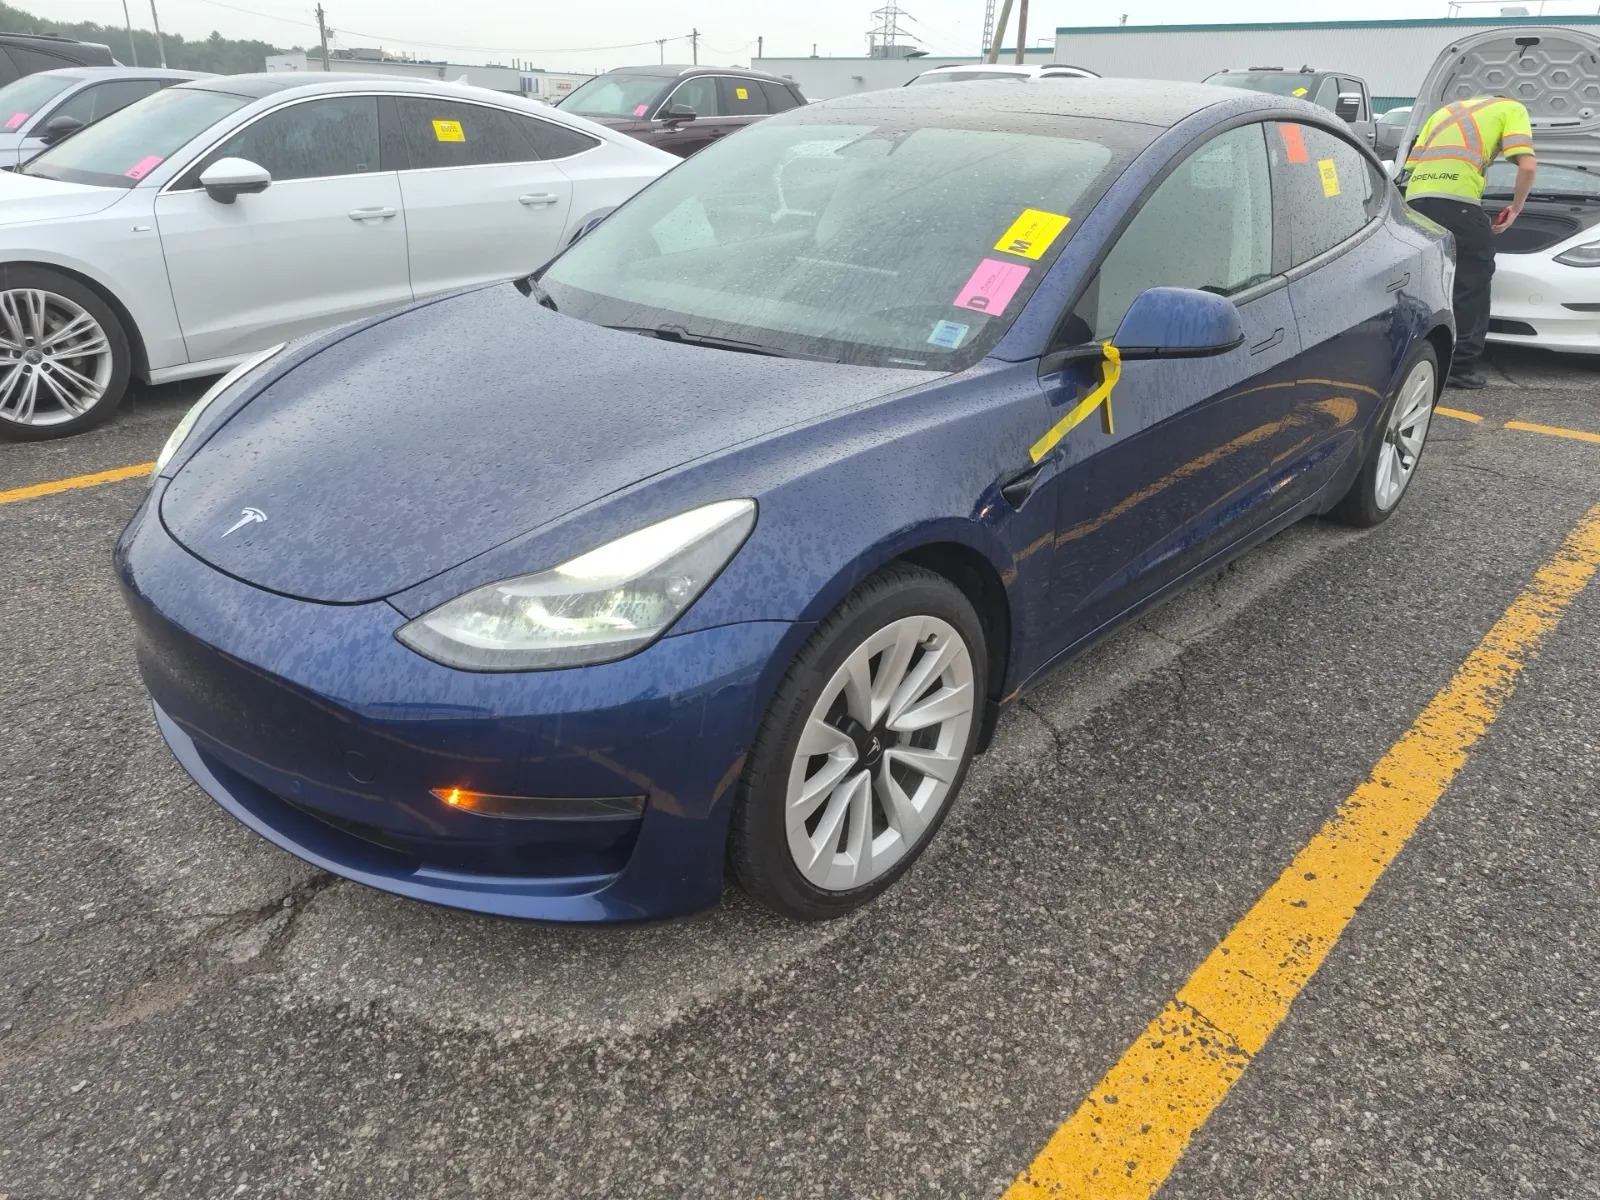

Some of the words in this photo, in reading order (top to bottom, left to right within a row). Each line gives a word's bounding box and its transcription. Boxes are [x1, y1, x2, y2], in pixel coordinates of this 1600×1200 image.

[1411, 172, 1460, 182] OPENLANE
[1008, 239, 1033, 253] M
[966, 296, 990, 310] D
